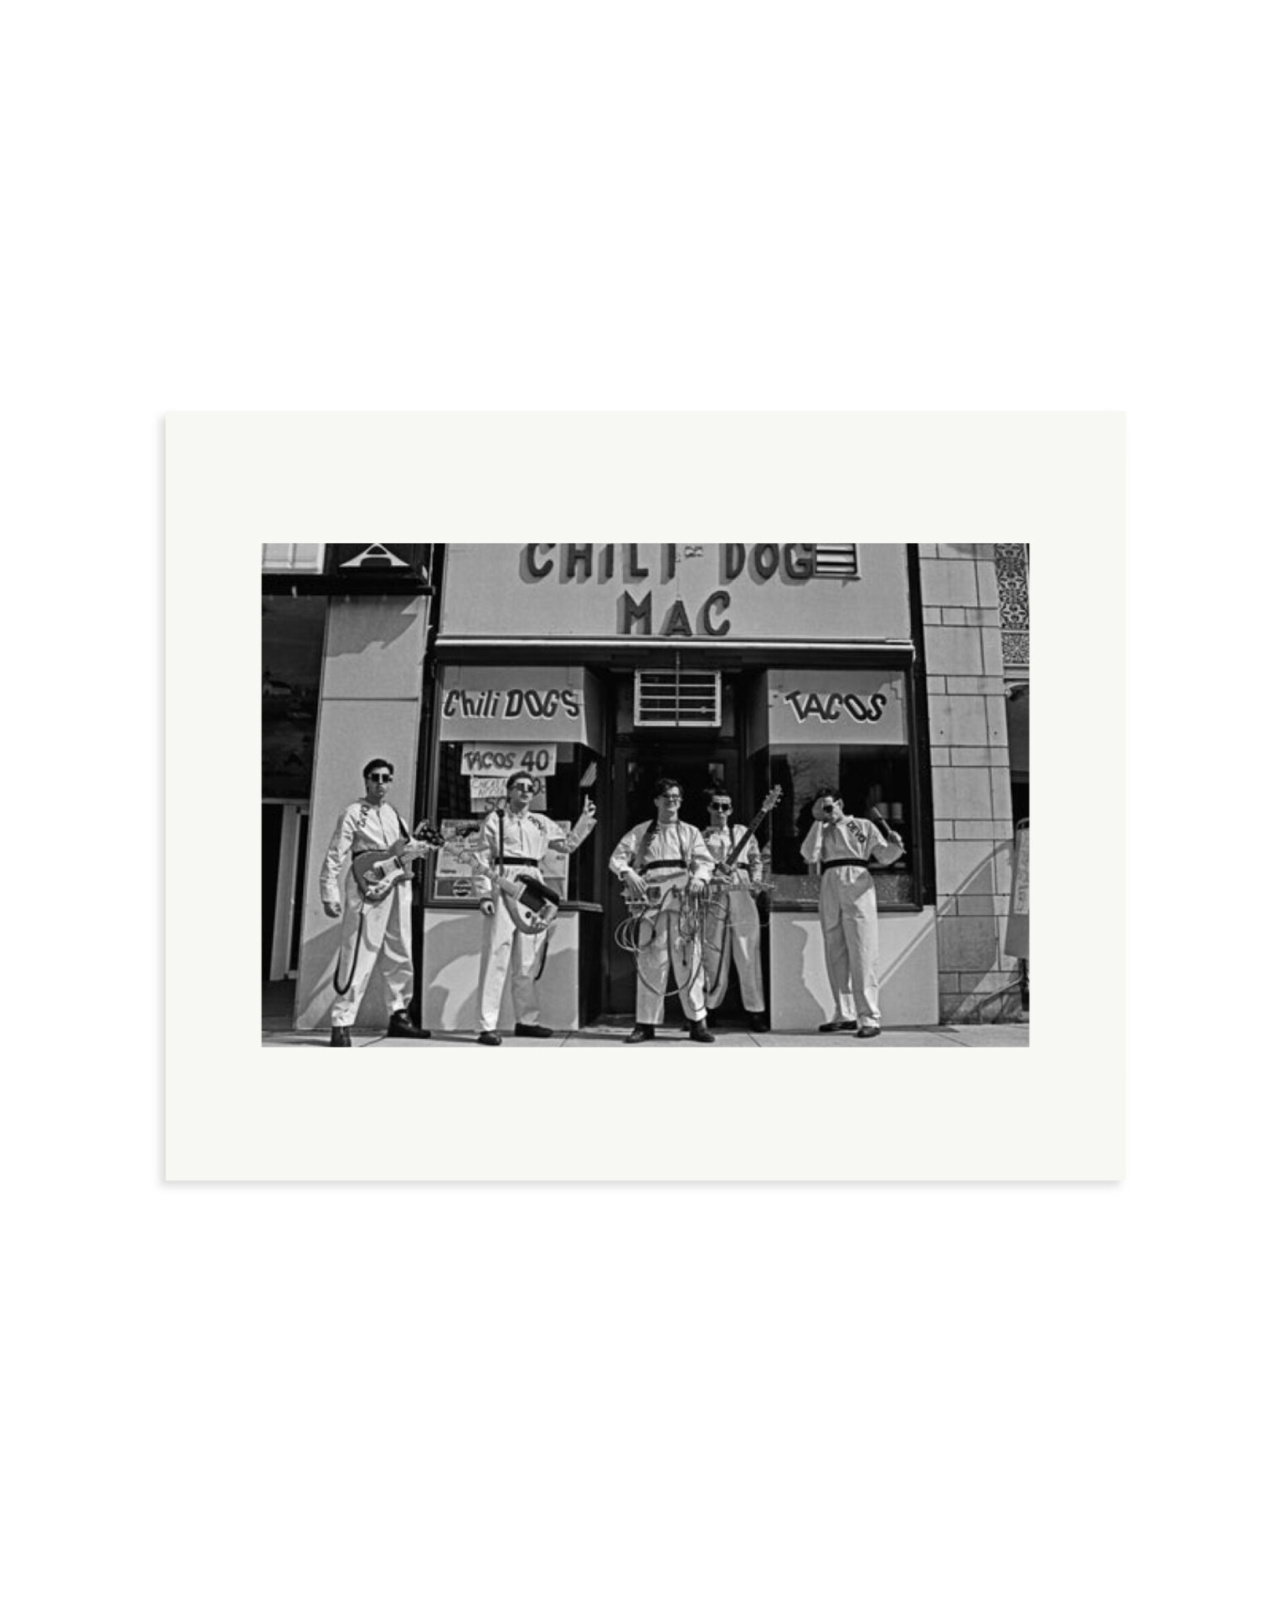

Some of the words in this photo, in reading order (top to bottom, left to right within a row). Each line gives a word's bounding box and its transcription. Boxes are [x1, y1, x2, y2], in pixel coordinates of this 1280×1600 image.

[521, 543, 677, 583] CHILI
[617, 590, 731, 637] MAC
[442, 688, 501, 719] Chili
[502, 688, 581, 719] DOGS
[784, 690, 888, 723] TACOS
[464, 750, 517, 771] TACOS
[520, 749, 550, 772] 40
[846, 820, 868, 844] DEVO
